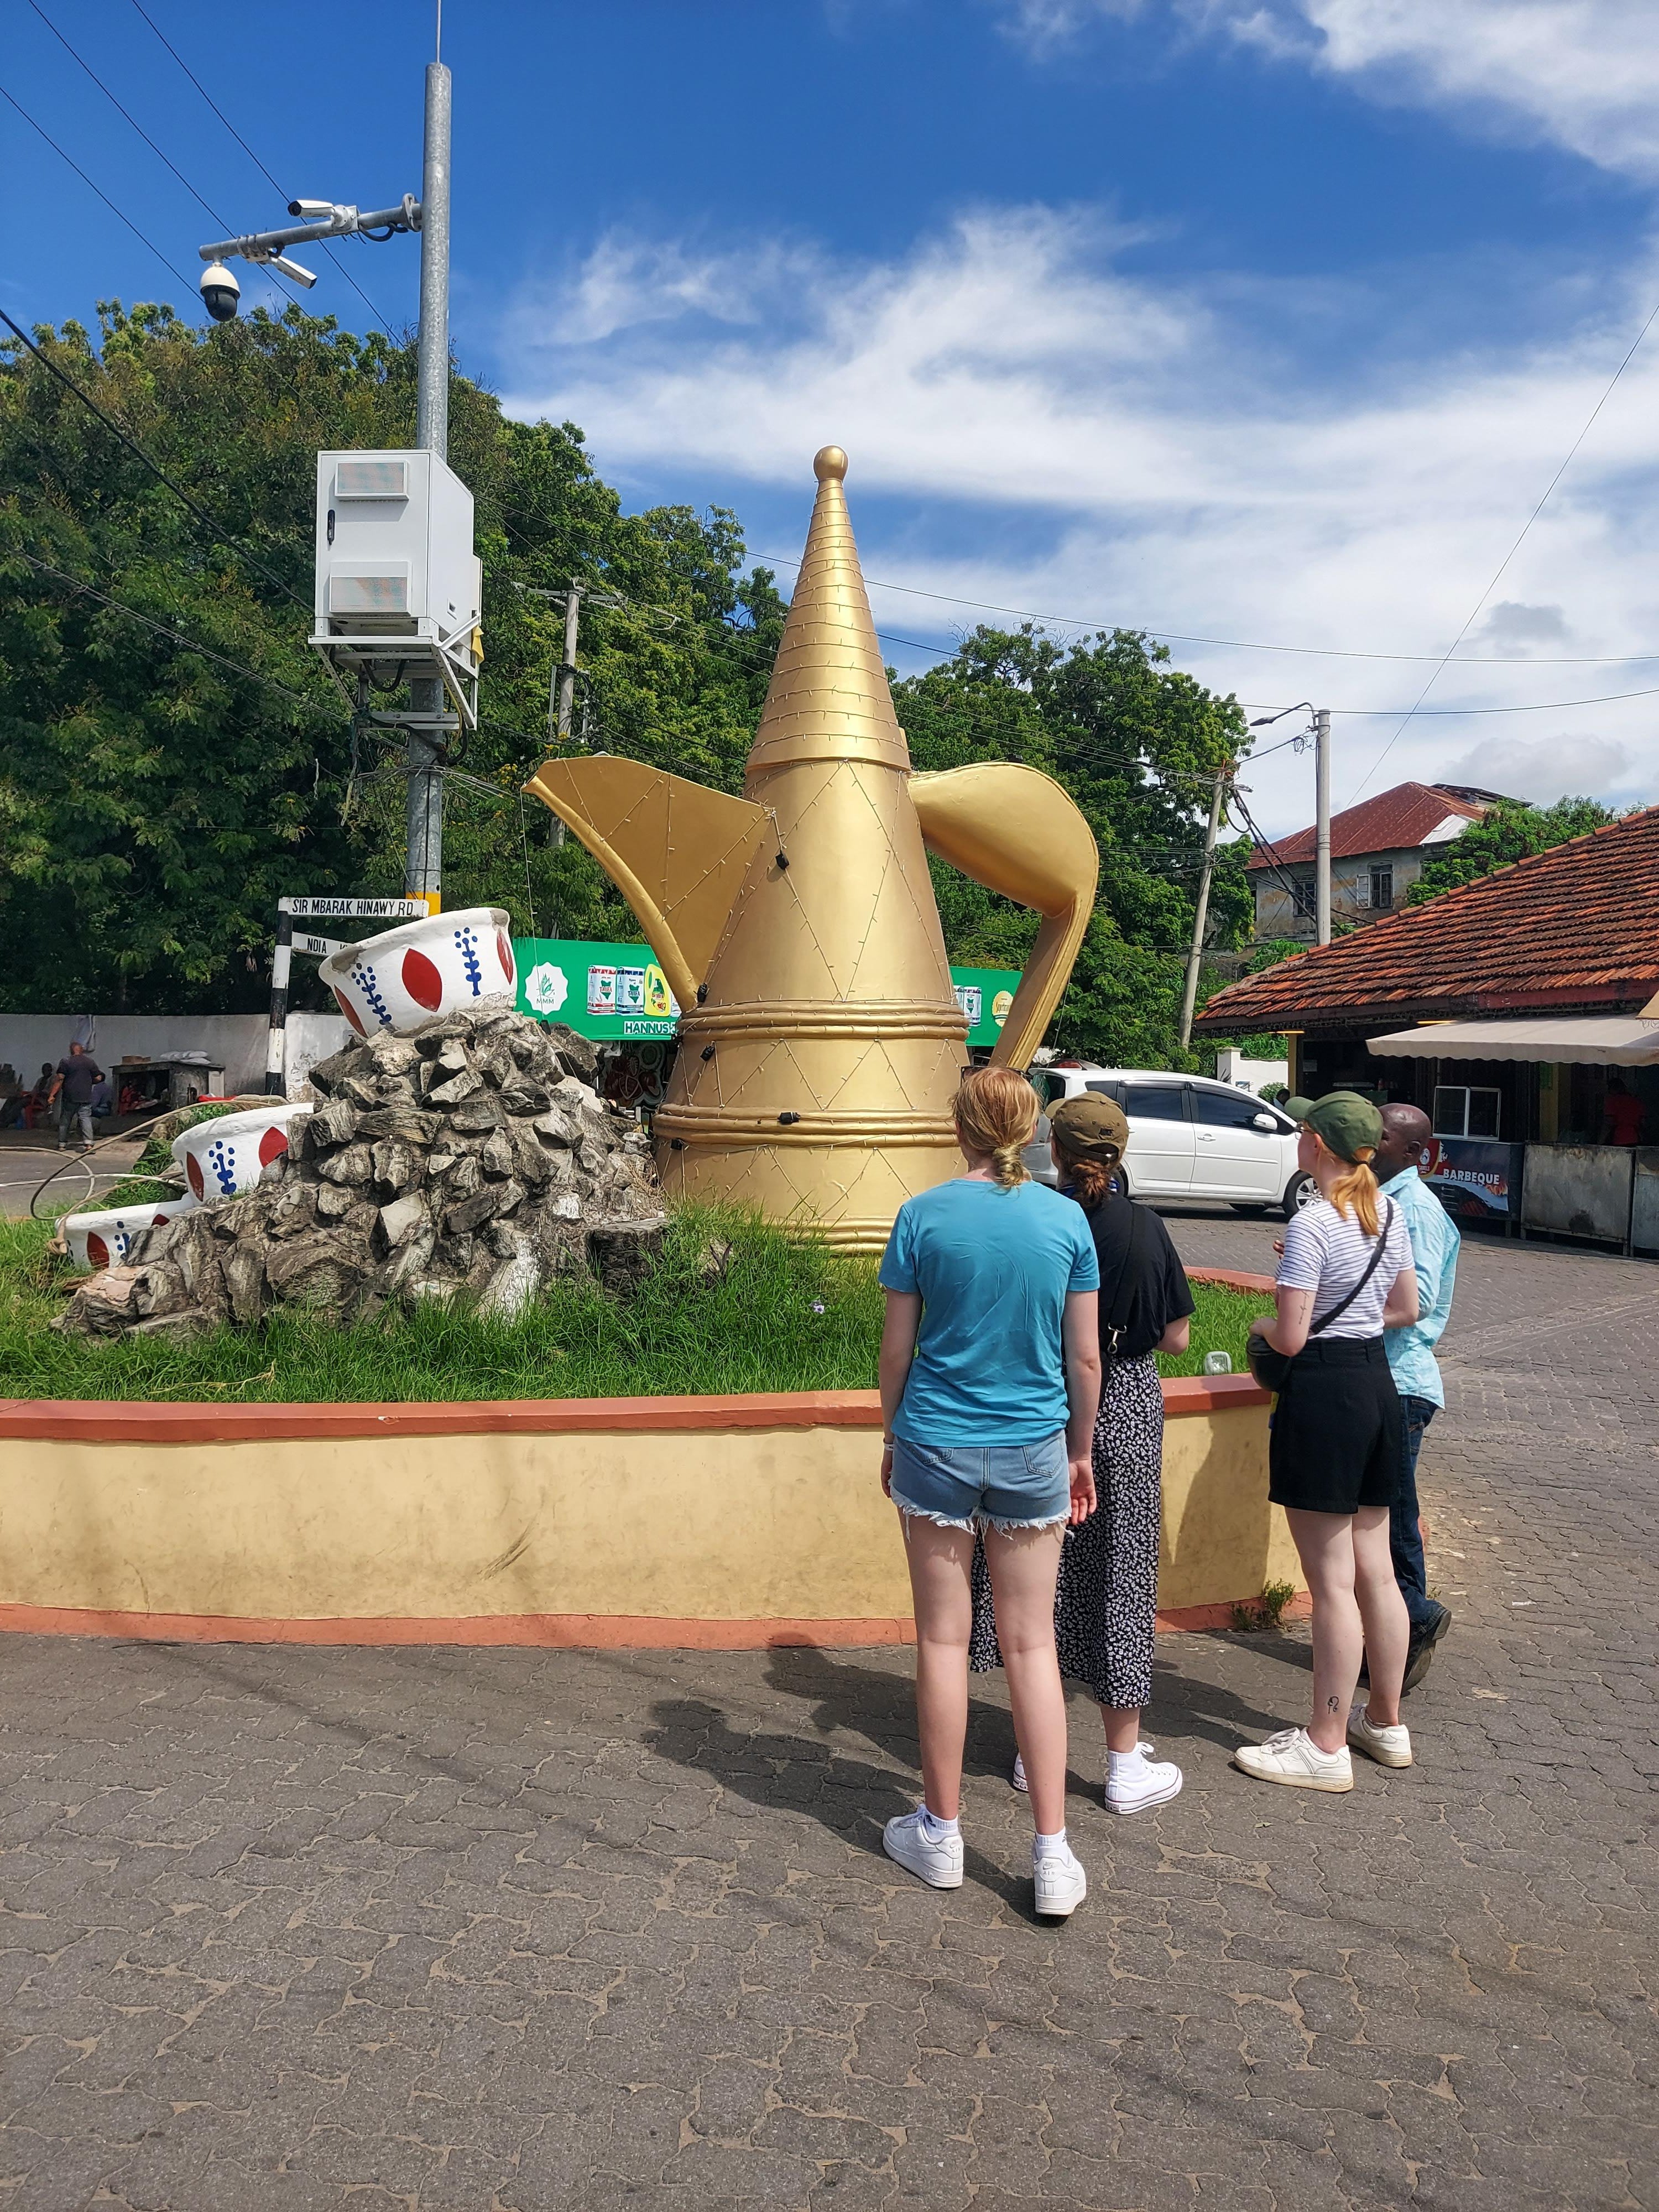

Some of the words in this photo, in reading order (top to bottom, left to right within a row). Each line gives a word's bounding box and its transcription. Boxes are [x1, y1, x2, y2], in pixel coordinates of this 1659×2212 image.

[292, 899, 308, 914] SIR
[311, 900, 353, 915] MBARAK
[357, 900, 395, 916] HINAWY
[398, 901, 414, 916] RD
[307, 938, 327, 954] NDIA
[624, 1021, 669, 1034] HANNUS
[1443, 1168, 1500, 1186] BARBEQUE
